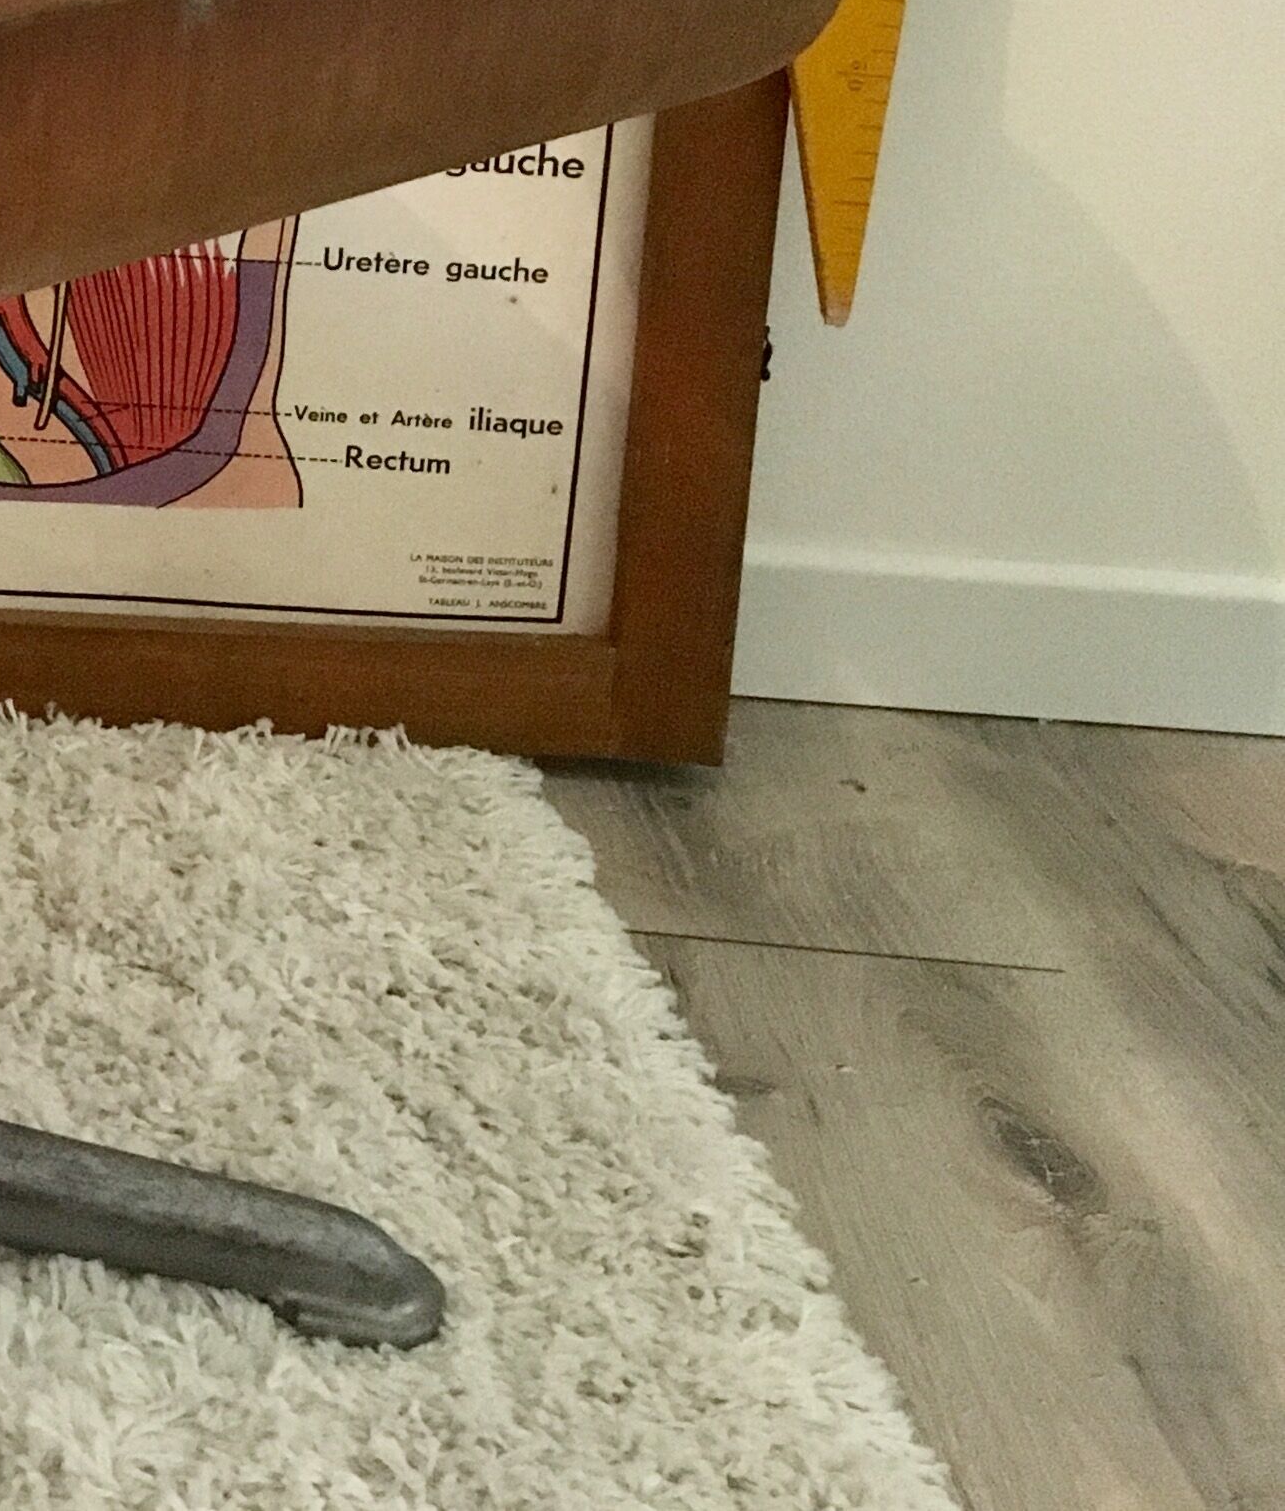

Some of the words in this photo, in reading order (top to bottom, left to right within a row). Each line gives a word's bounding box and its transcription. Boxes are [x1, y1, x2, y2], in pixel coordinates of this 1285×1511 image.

[323, 246, 430, 276] Uretère
[445, 257, 549, 284] gauche
[294, 404, 348, 424] Veine
[359, 411, 379, 425] et
[390, 409, 453, 430] Artère
[469, 406, 564, 440] iliaque
[344, 444, 451, 475] Rectum
